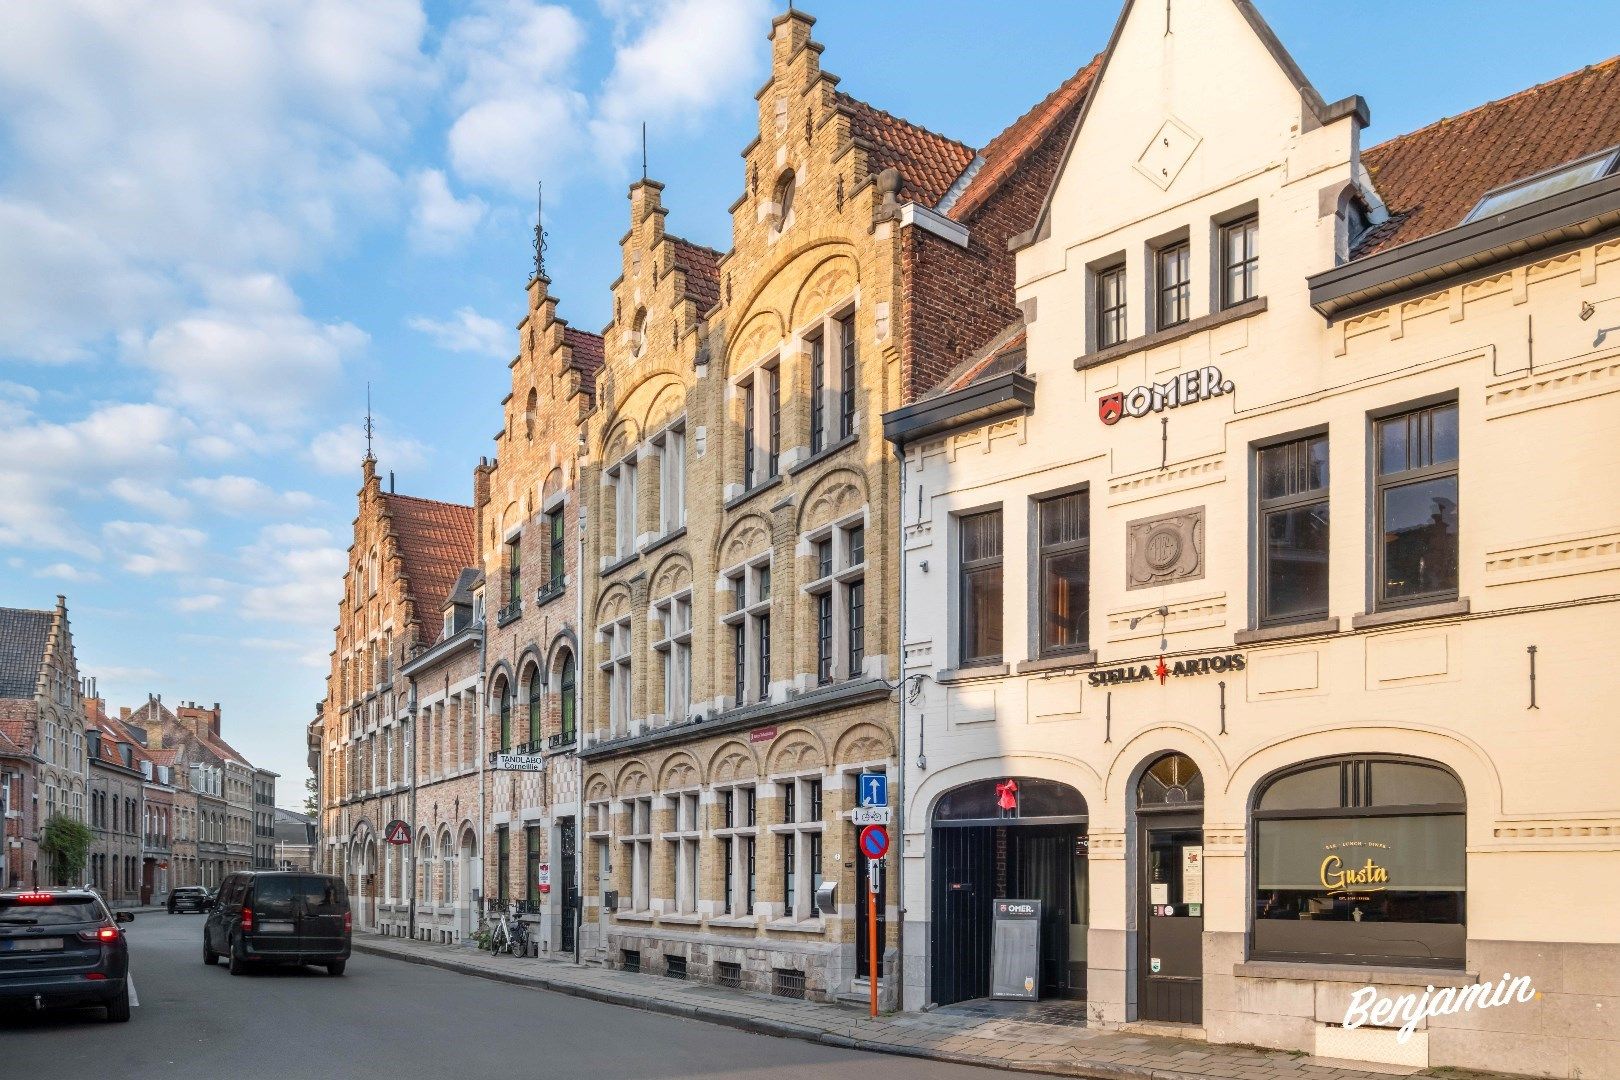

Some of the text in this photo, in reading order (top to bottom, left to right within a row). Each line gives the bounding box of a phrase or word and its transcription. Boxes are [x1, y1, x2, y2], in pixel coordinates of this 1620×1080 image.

[1125, 366, 1235, 418] OMER.
[1088, 653, 1245, 687] STELLA ARTOIS
[500, 755, 542, 765] TANDLABO
[1320, 855, 1389, 889] Gusta
